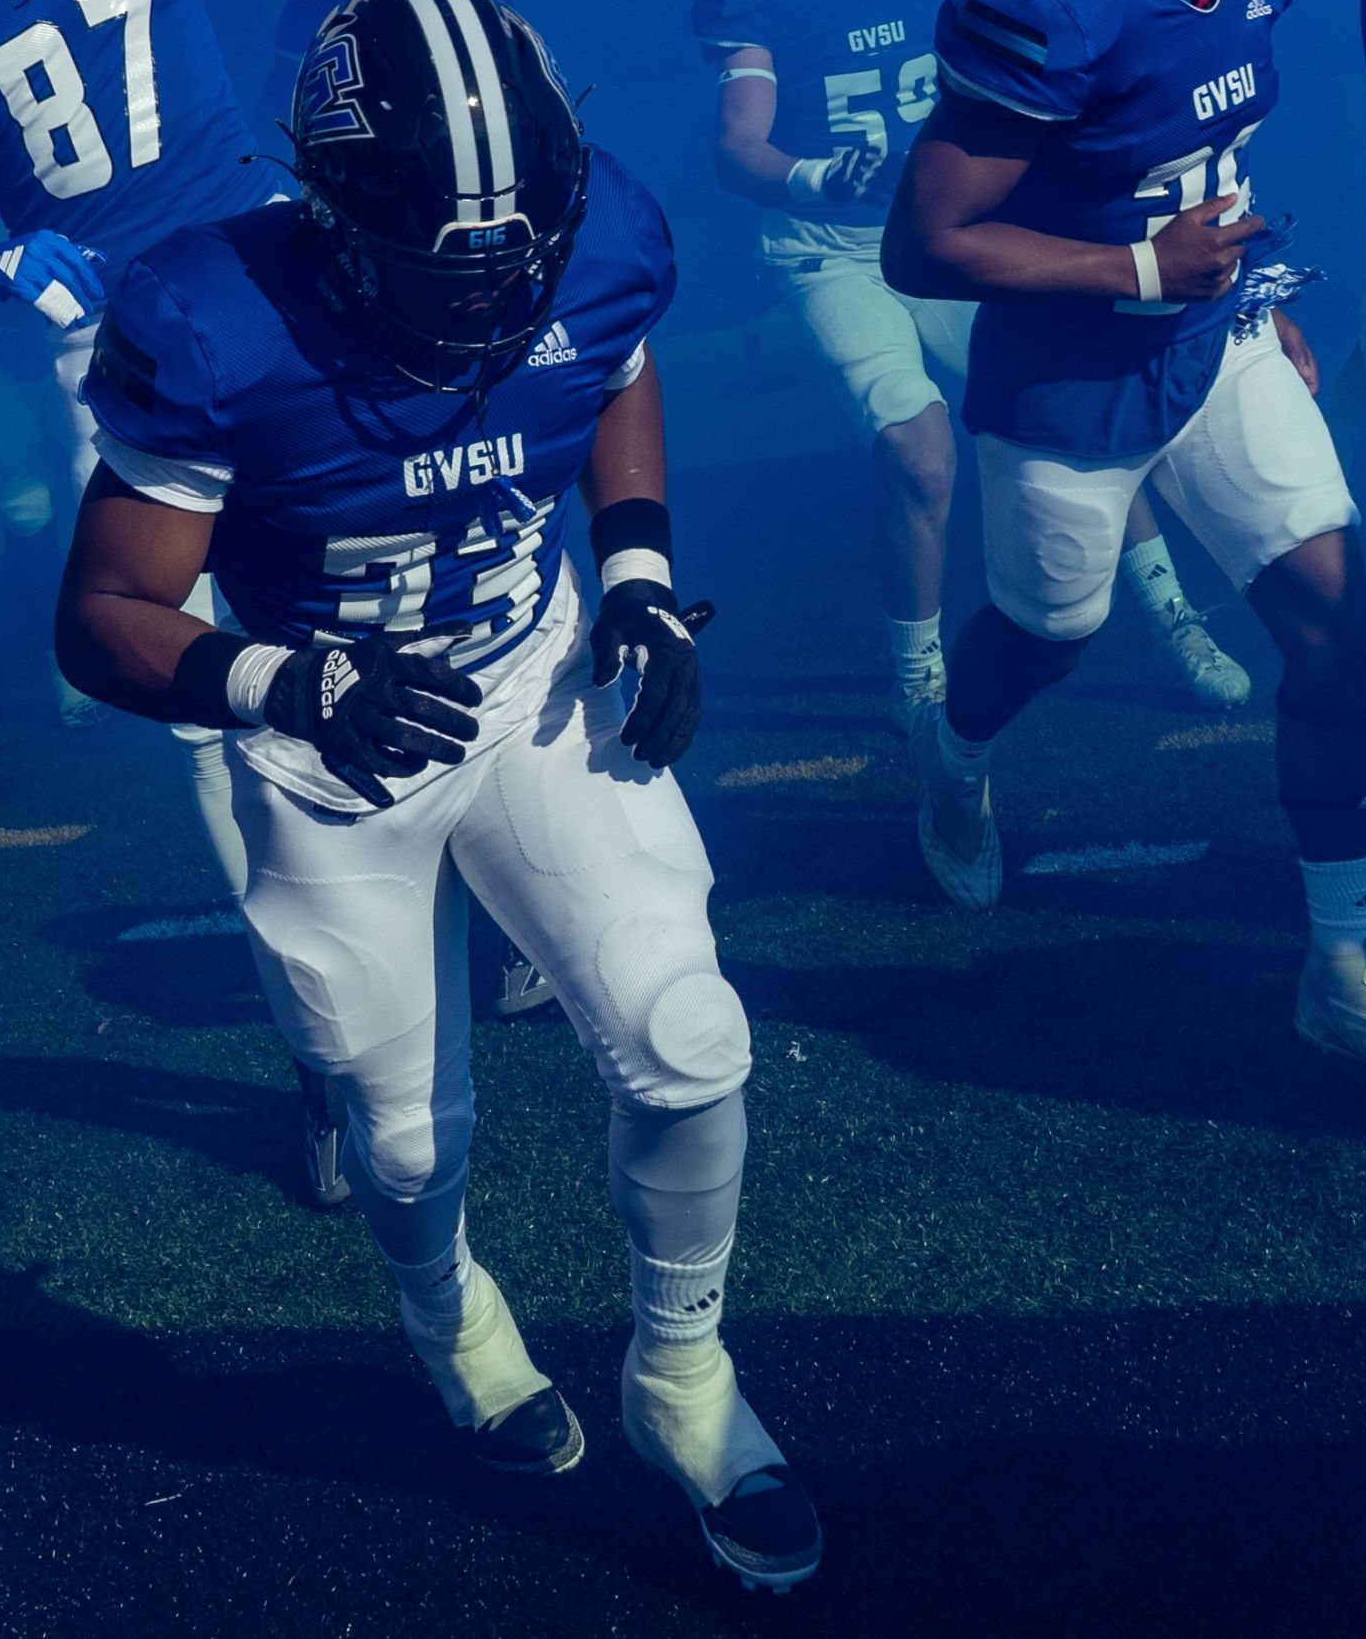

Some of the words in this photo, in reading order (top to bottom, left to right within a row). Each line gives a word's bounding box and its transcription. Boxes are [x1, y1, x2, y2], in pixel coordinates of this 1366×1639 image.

[848, 20, 906, 52] GVSU
[1192, 63, 1256, 121] GVSU
[469, 227, 505, 248] 616
[528, 345, 577, 367] adidas
[403, 433, 525, 498] GVSU
[321, 649, 340, 720] adidas
